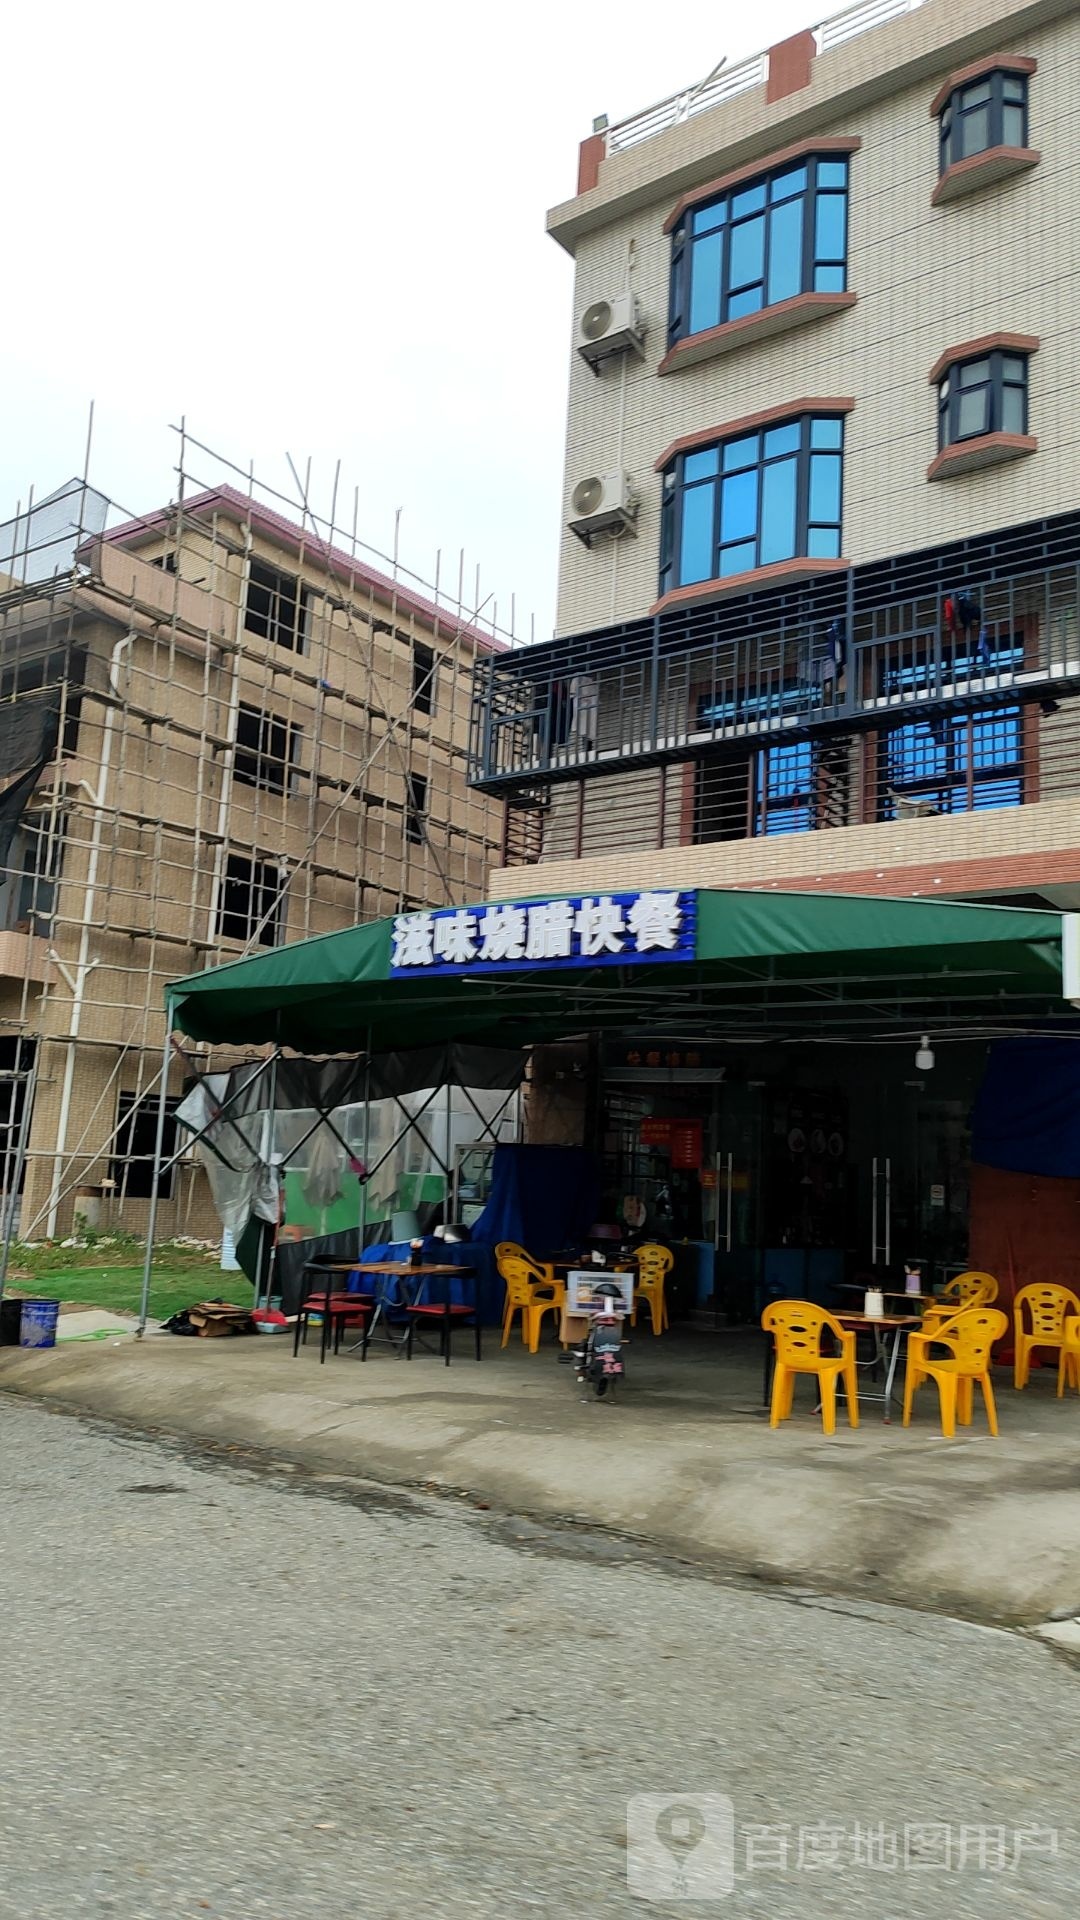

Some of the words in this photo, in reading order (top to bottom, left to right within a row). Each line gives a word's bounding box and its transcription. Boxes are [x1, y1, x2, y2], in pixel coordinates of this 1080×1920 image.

[391, 891, 681, 967] 滋味烧腊快餐
